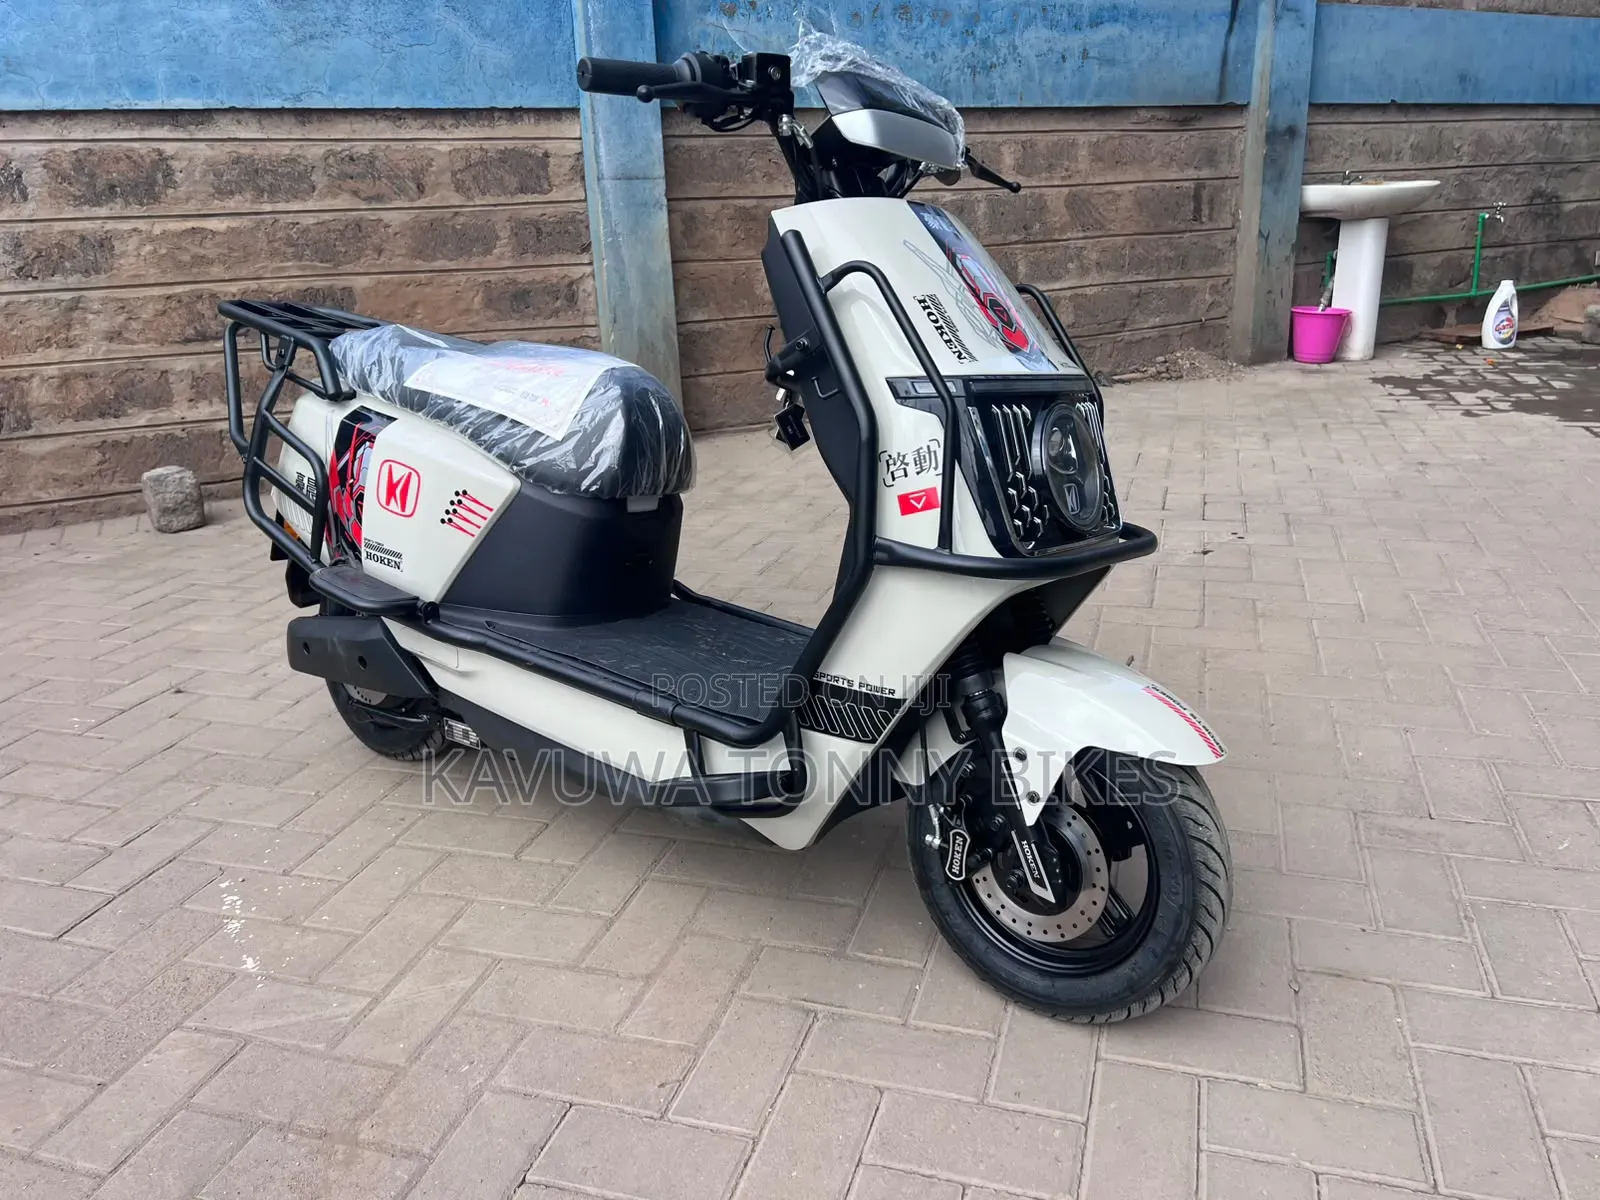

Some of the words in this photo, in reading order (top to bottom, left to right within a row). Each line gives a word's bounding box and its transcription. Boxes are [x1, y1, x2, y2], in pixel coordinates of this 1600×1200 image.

[916, 297, 968, 361] HOKEN
[366, 550, 401, 570] HOKEN
[812, 671, 854, 688] SPORTS
[858, 681, 896, 697] POWER
[952, 835, 964, 875] HOKEN
[1020, 839, 1040, 879] HOKEN
